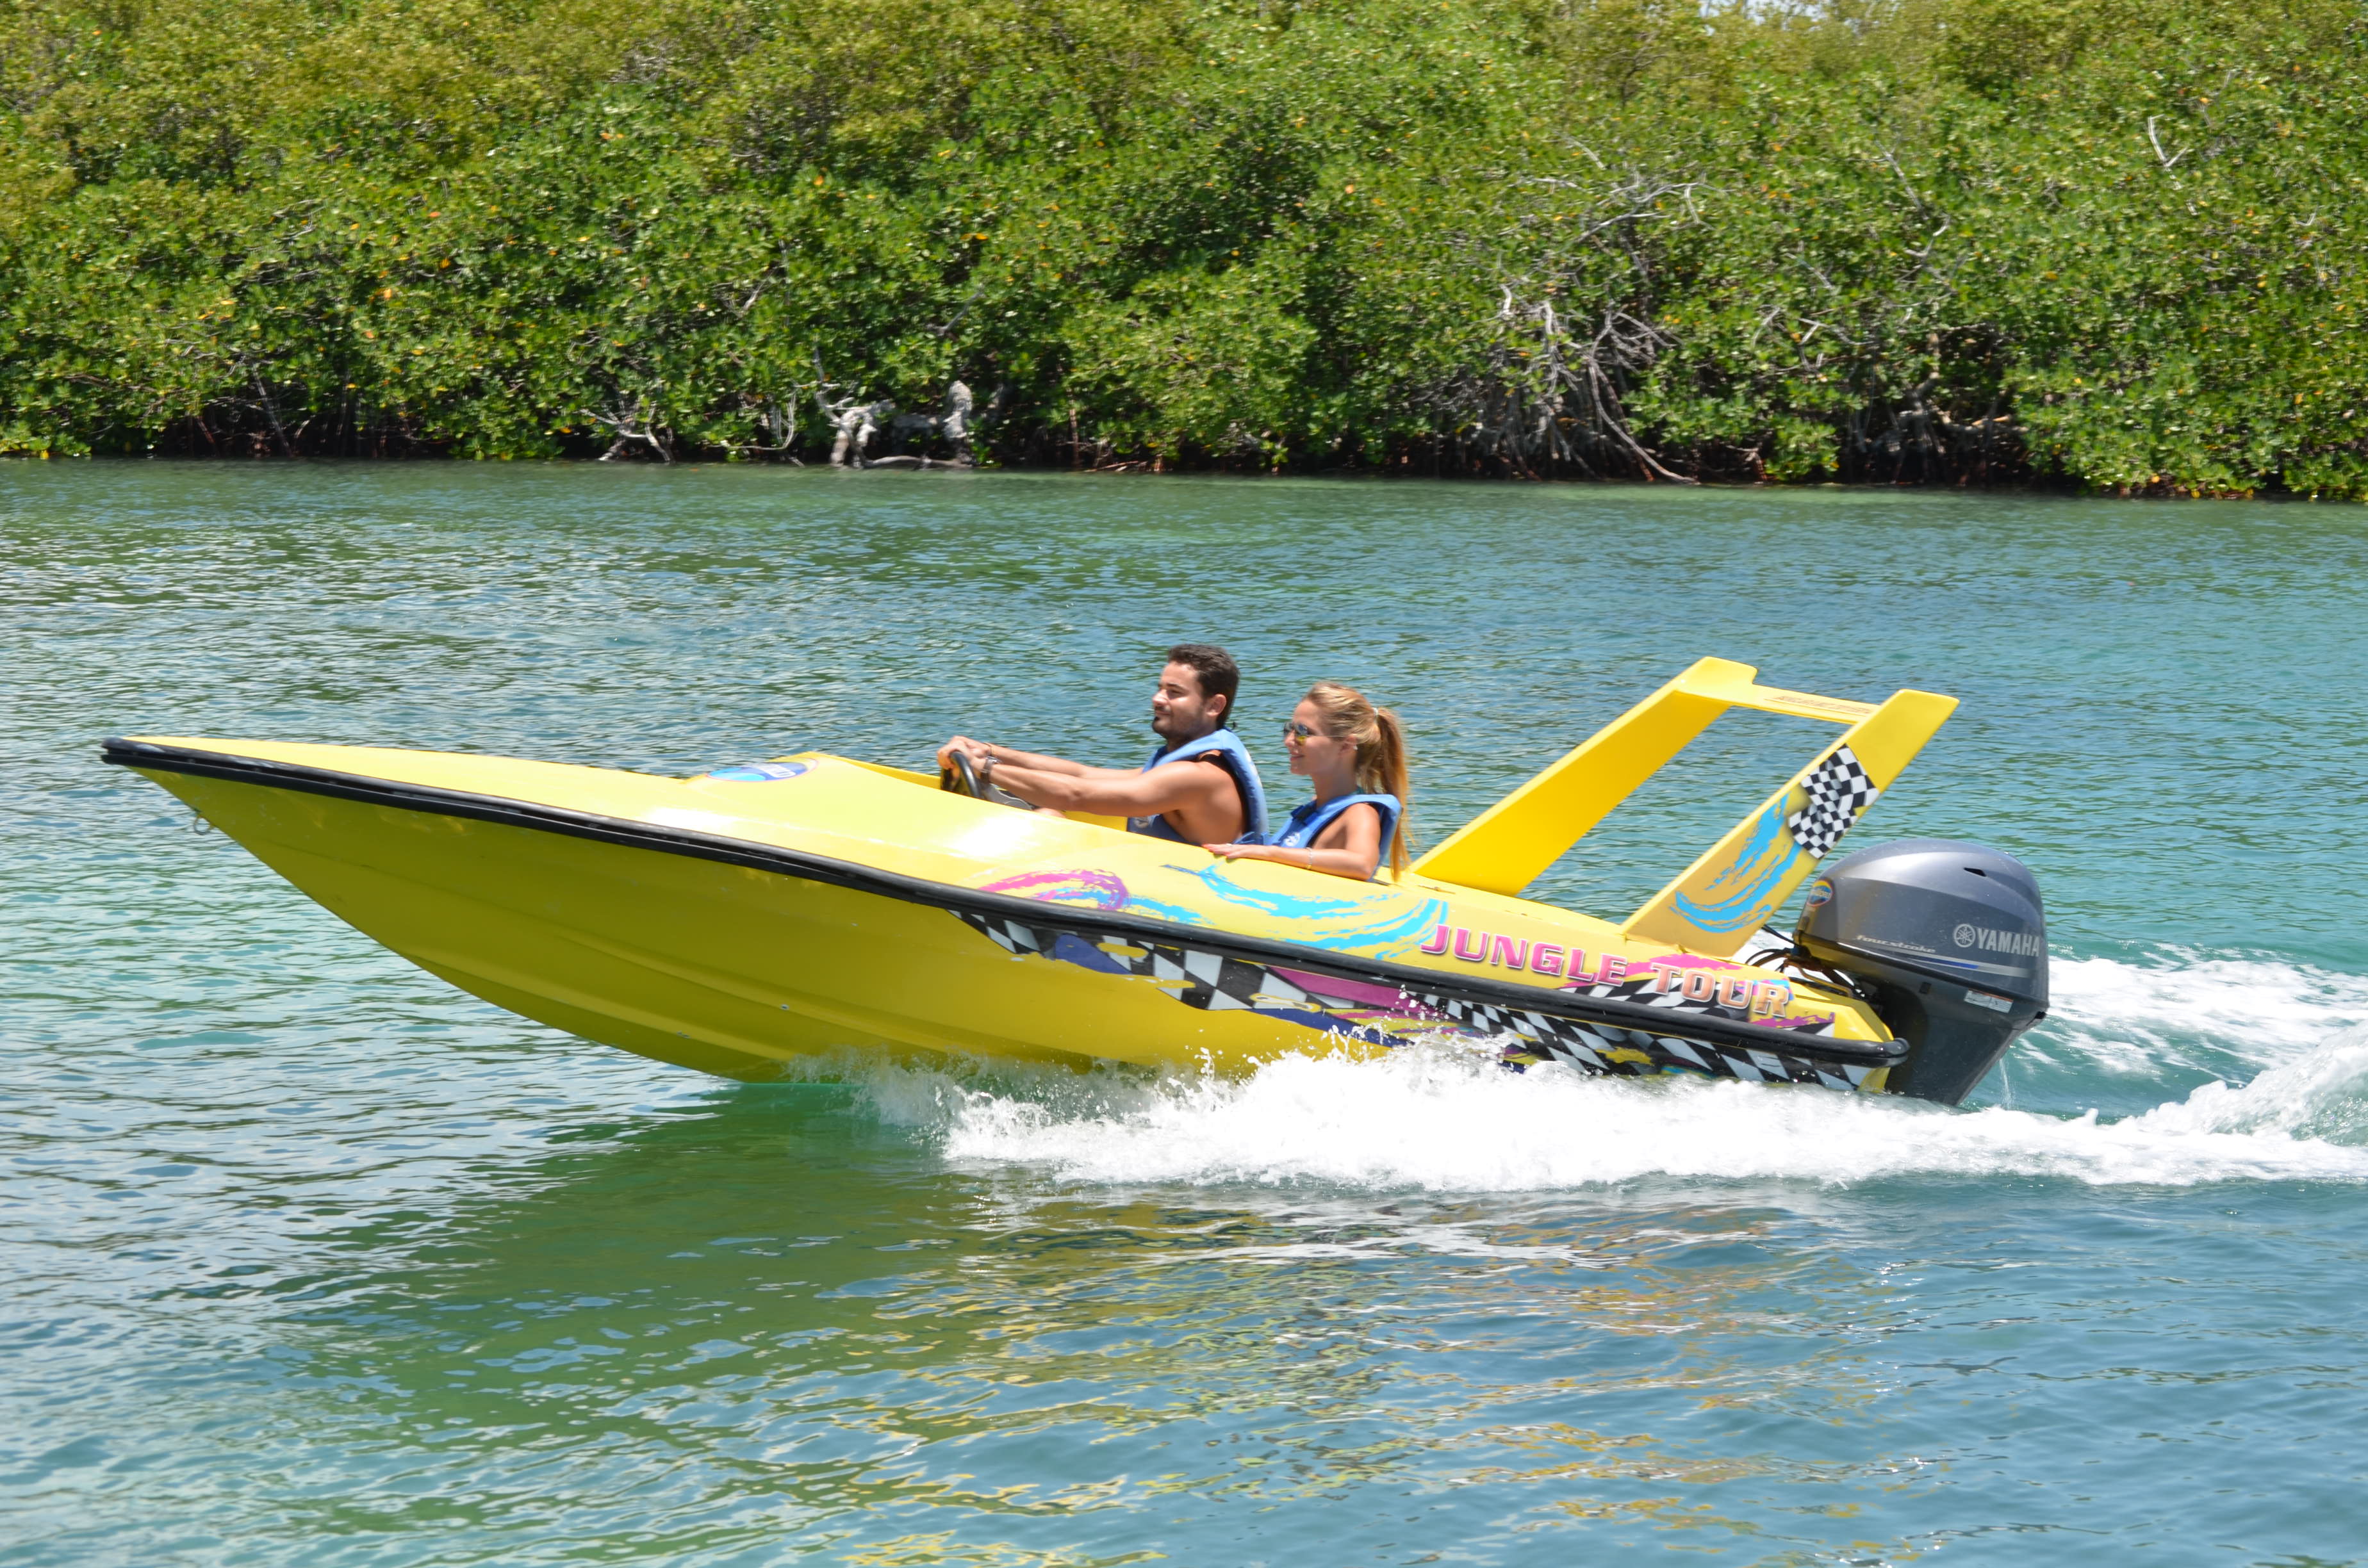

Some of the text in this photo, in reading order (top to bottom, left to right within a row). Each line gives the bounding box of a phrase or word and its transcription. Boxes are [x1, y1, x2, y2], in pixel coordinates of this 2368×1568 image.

[1420, 924, 1789, 1018] JUNGLE TOUR
[1978, 928, 2040, 957] YAMAHA
